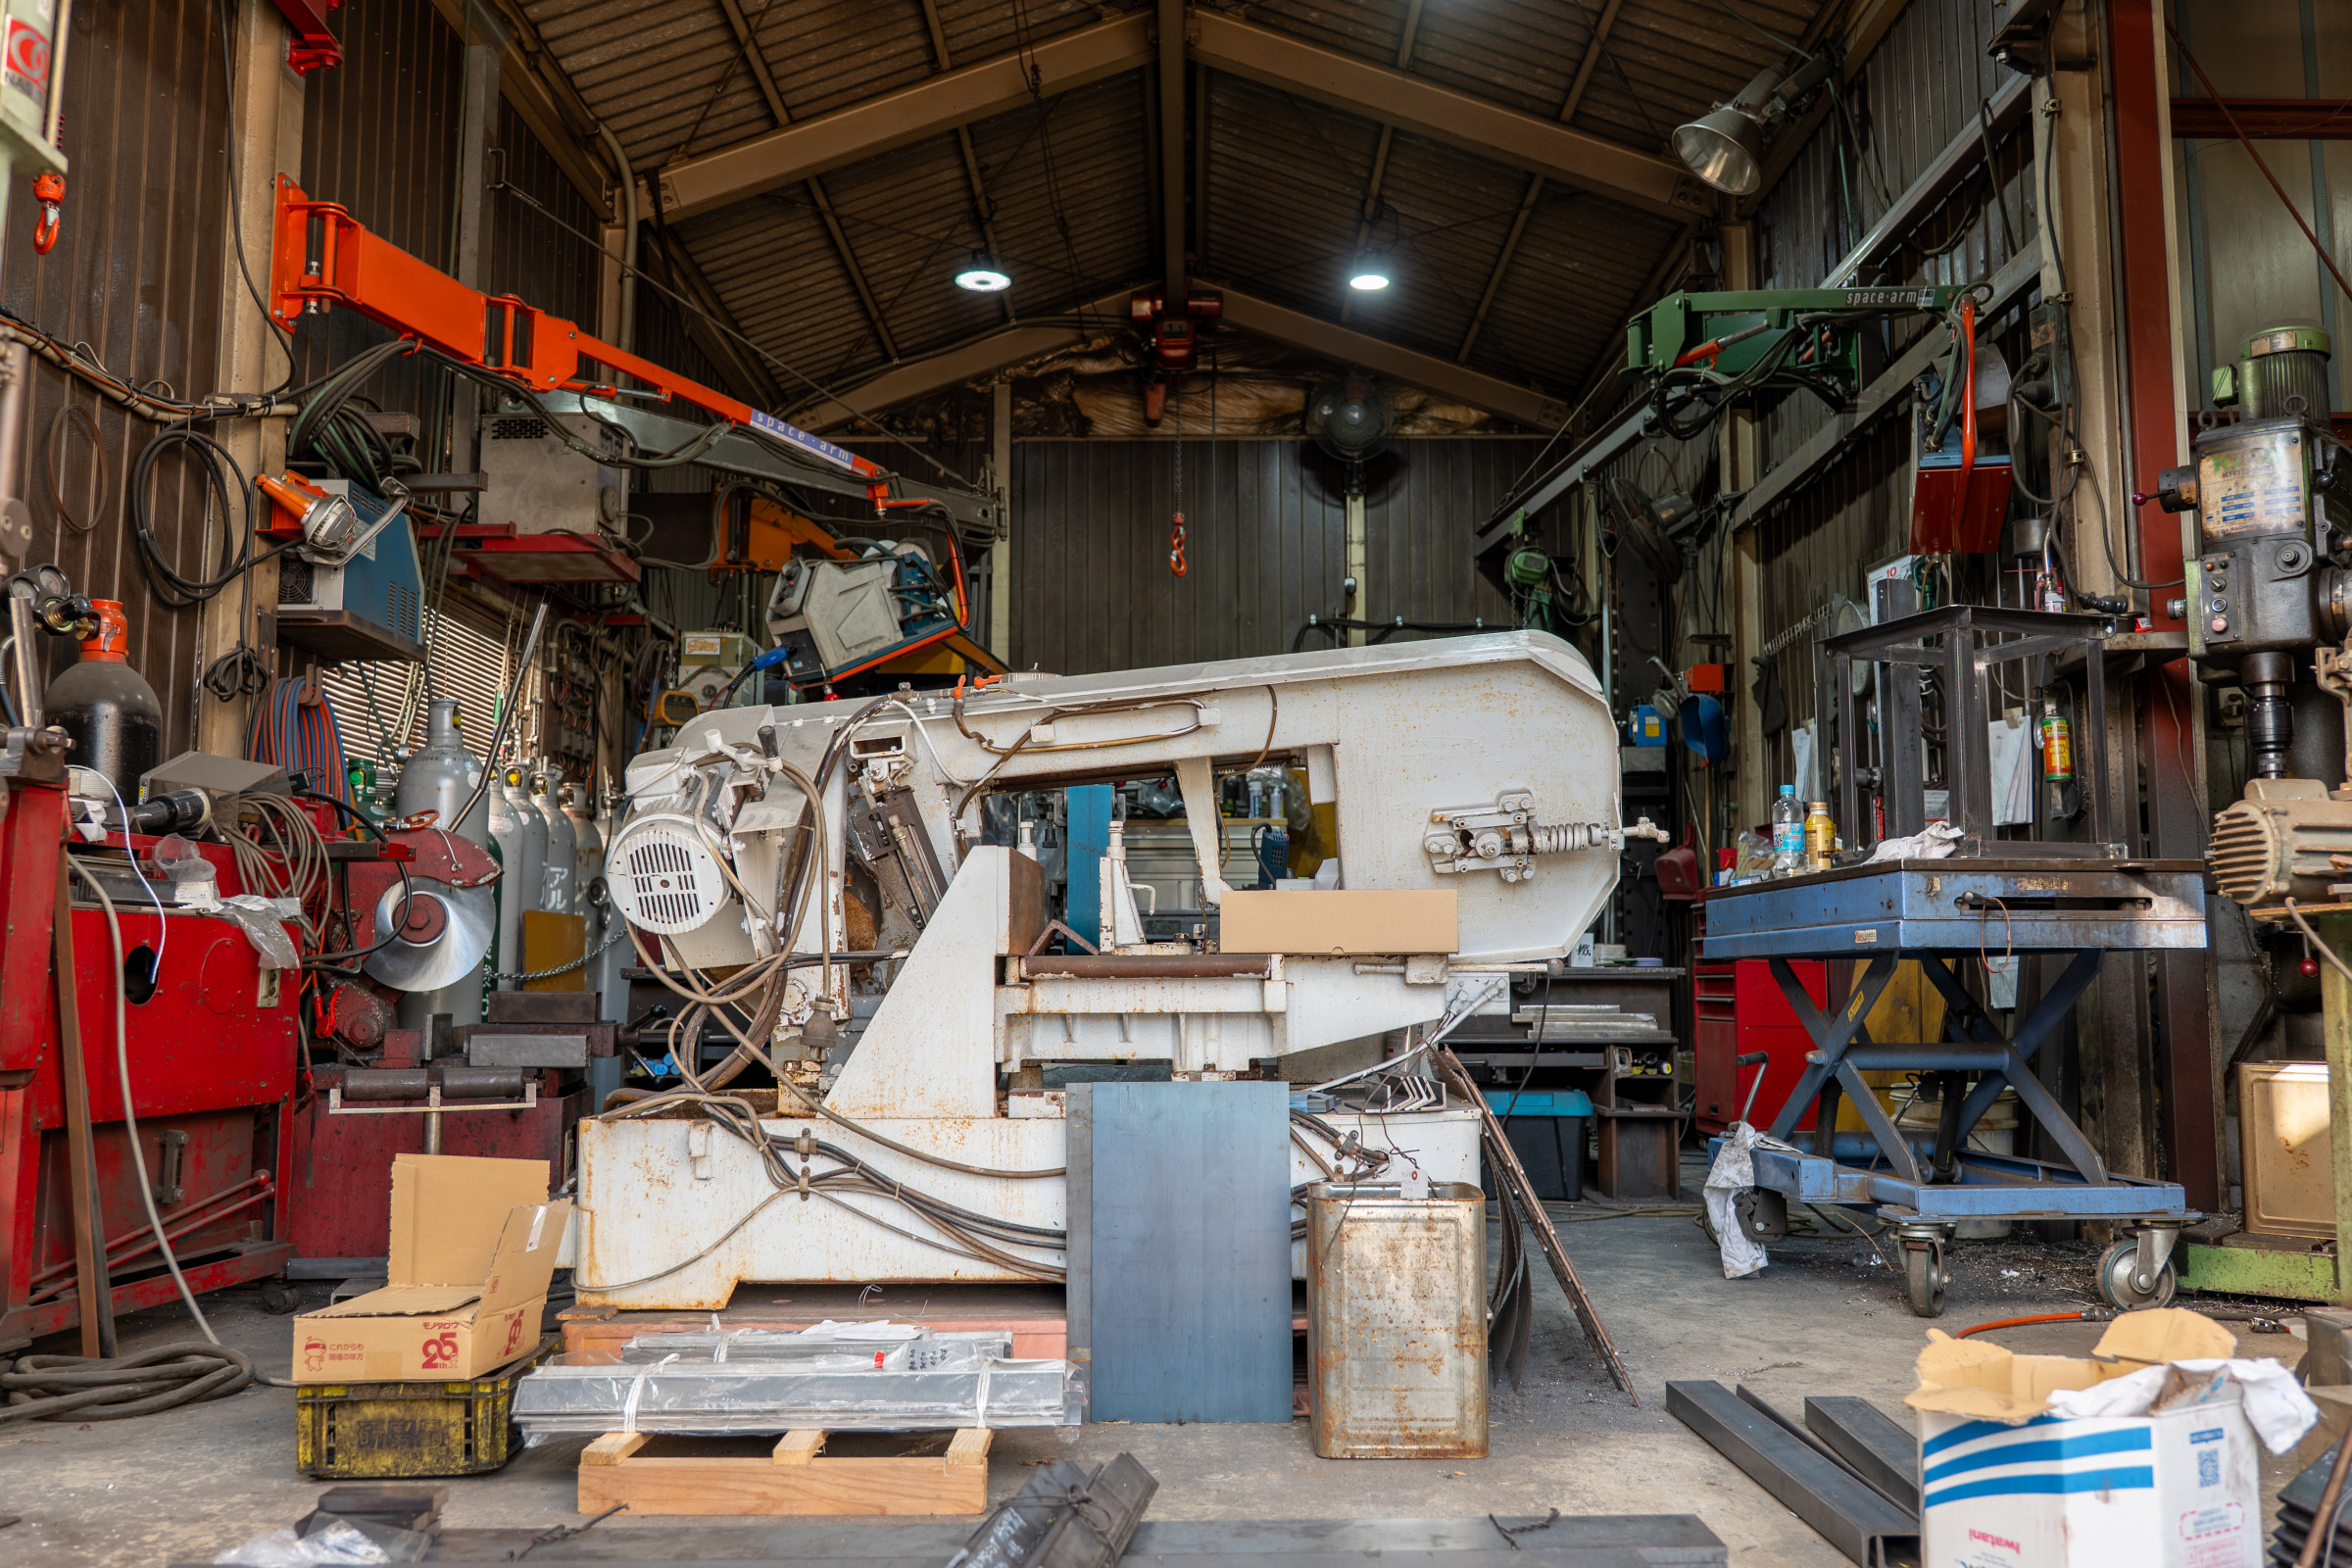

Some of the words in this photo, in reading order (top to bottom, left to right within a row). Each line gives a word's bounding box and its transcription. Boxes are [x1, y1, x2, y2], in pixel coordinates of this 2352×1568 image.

[547, 866, 569, 913] アル
[422, 1321, 460, 1330] モノタロウ
